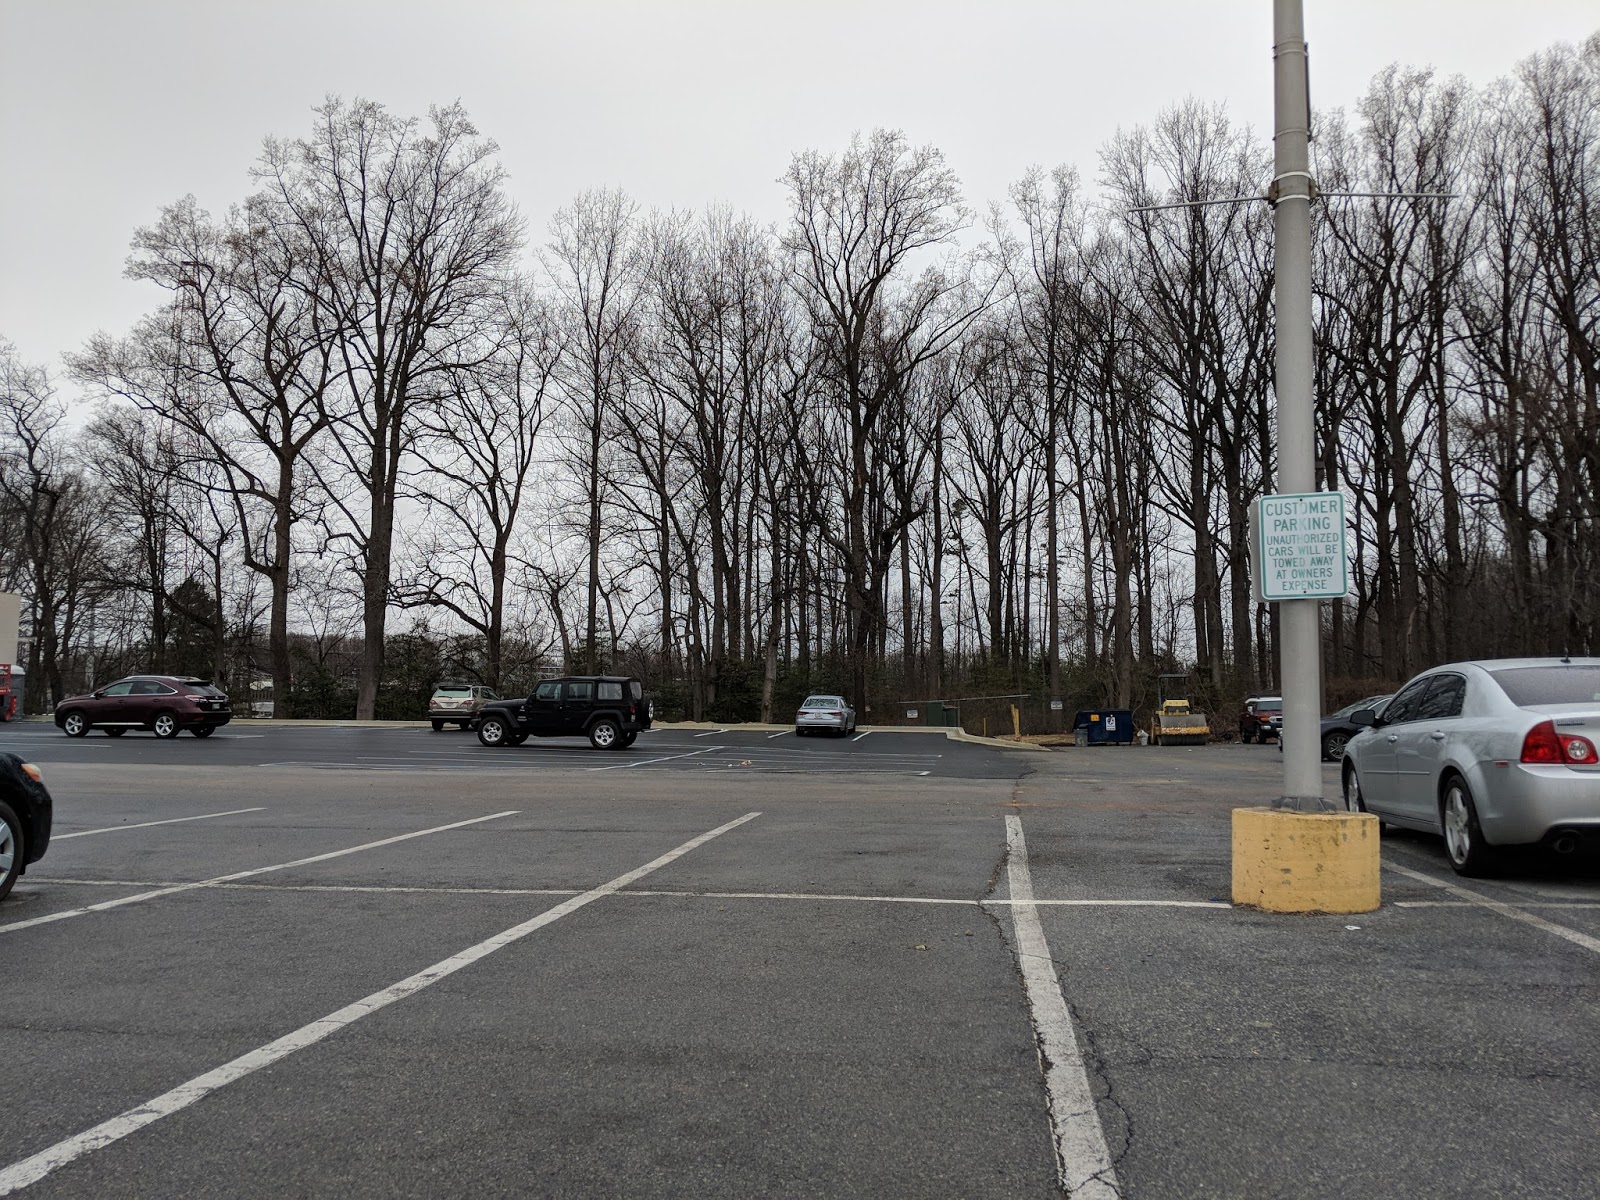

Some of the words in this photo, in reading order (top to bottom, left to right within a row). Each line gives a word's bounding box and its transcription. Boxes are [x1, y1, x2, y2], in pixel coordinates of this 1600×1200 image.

[1266, 500, 1338, 516] CUSTOMER
[1274, 517, 1331, 532] PARKING
[1268, 547, 1294, 557] CARS
[1299, 545, 1321, 556] WILL
[1325, 544, 1338, 554] BE
[1273, 557, 1306, 568] TOWED
[1310, 556, 1334, 566] AWAY
[1276, 569, 1287, 580] AT
[1291, 567, 1333, 579] OWNERS
[1282, 580, 1327, 591] EXPENSE
